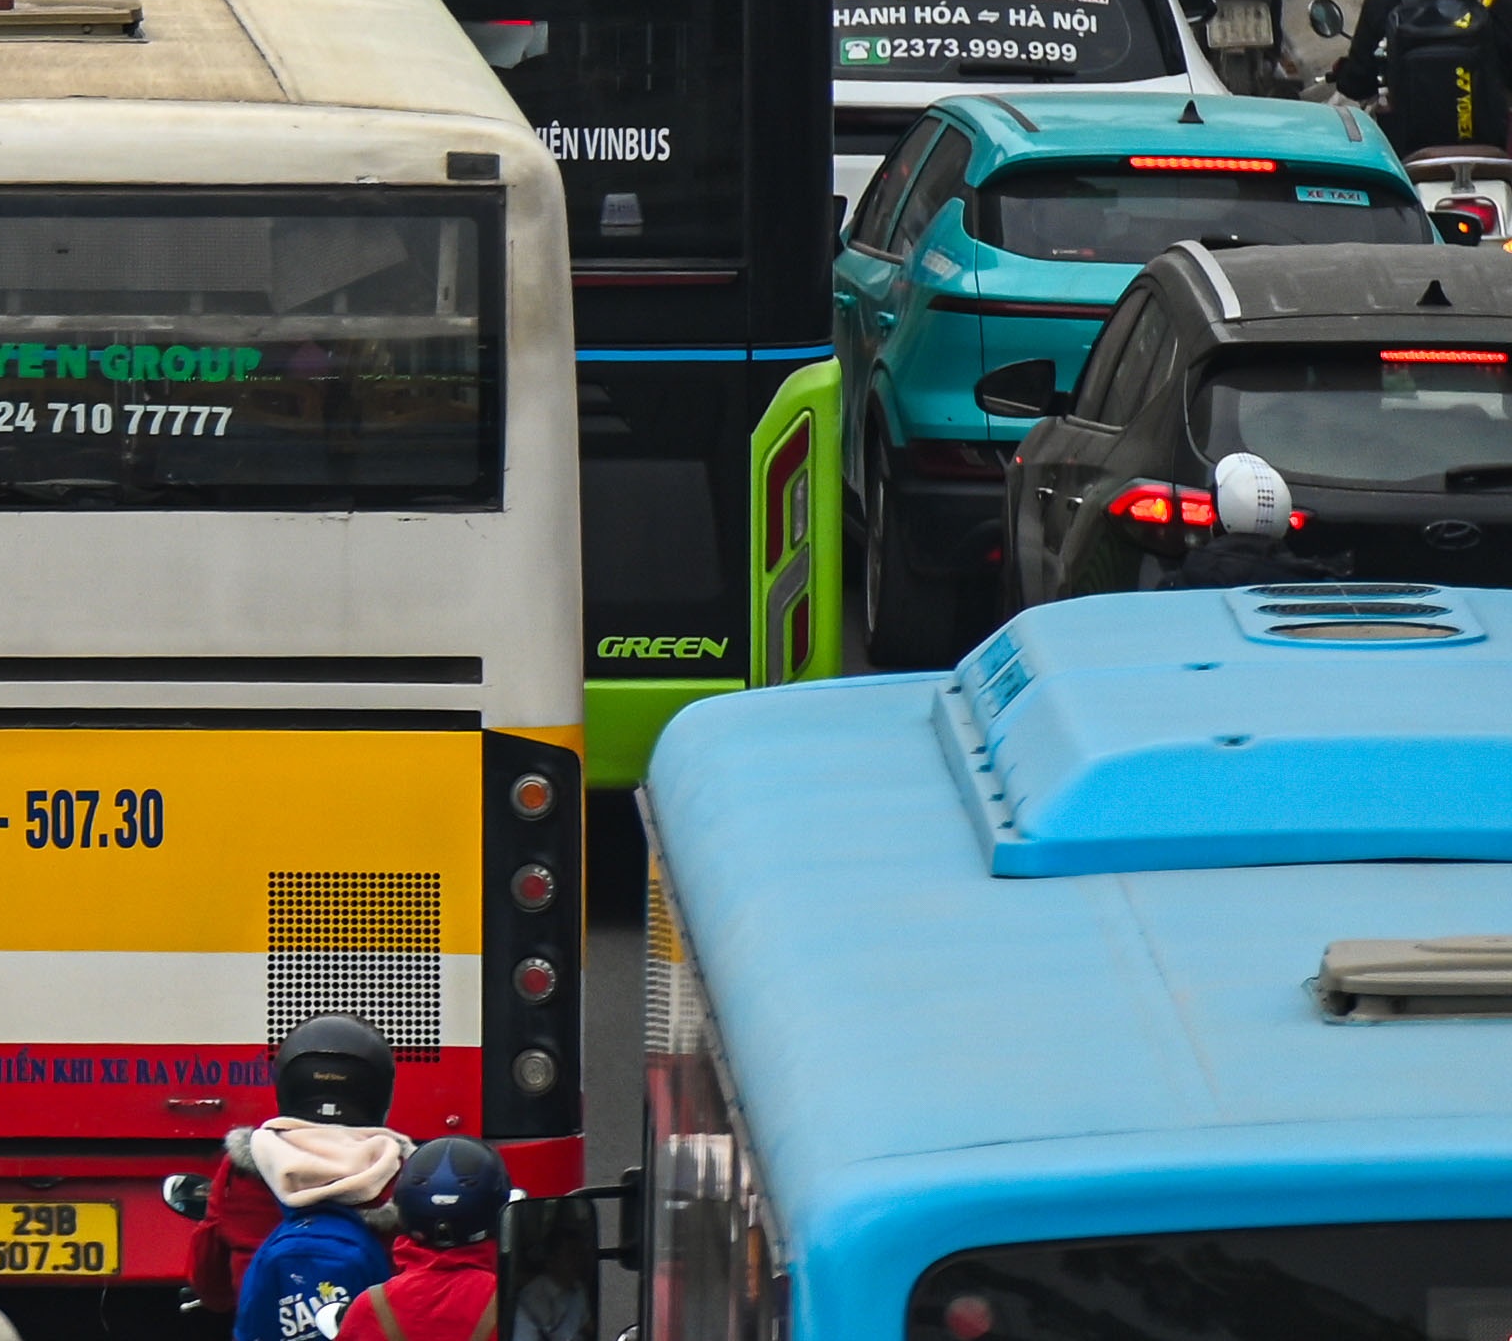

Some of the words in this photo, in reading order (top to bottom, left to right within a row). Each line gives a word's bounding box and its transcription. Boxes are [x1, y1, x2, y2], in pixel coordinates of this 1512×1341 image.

[832, 6, 907, 27] HANH
[914, 2, 971, 26] HÓA
[1009, 4, 1045, 28] HÀ
[1053, 8, 1098, 37] NỘI
[875, 39, 1078, 64] 02373.999.999
[534, 121, 579, 160] IÊN
[583, 128, 671, 161] VINBUS
[100, 345, 262, 384] GROUP
[48, 402, 113, 434] 710
[123, 404, 232, 437] 77777
[597, 636, 728, 658] GREEN
[26, 789, 164, 849] 507.30
[54, 1059, 93, 1084] KHI
[101, 1058, 129, 1083] XE
[135, 1059, 168, 1084] RA
[175, 1053, 222, 1086] VÀO
[11, 1204, 77, 1237] 29B
